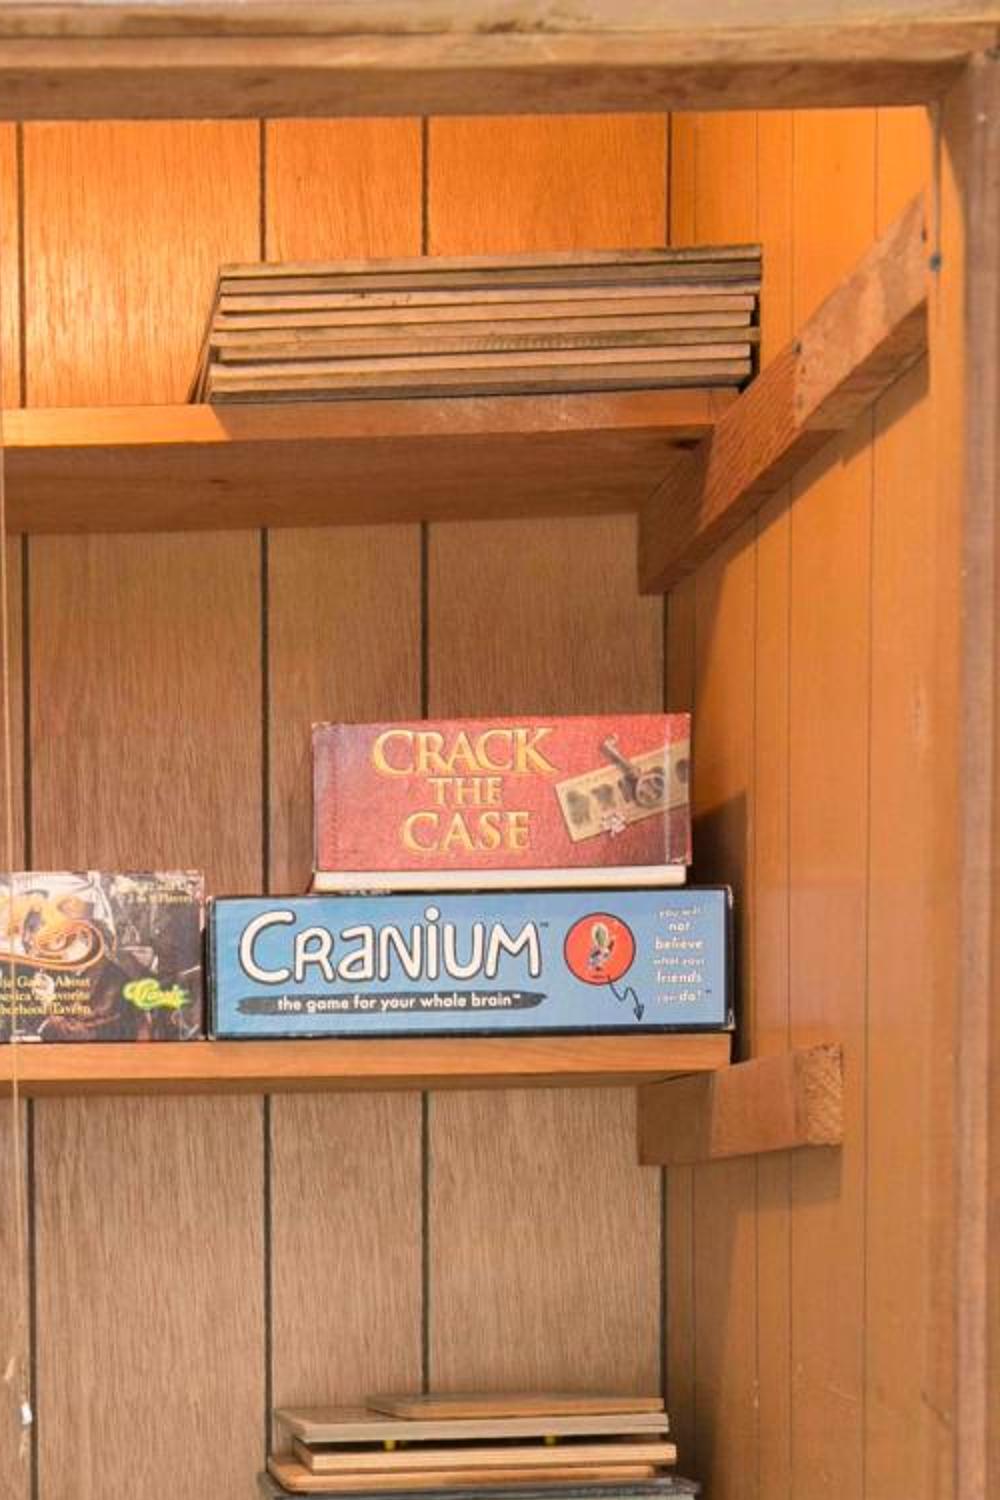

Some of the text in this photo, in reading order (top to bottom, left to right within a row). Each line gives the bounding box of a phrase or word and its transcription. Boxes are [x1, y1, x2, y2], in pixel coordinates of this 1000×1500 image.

[371, 727, 557, 775] CRACK
[430, 777, 503, 806] THE
[403, 811, 531, 851] CASE
[668, 921, 690, 932] not
[655, 937, 704, 950] believe
[656, 971, 702, 984] friends
[277, 996, 302, 1011] the
[306, 1000, 349, 1013] game
[354, 995, 376, 1009] for
[380, 997, 415, 1012] your
[419, 993, 467, 1008] whole
